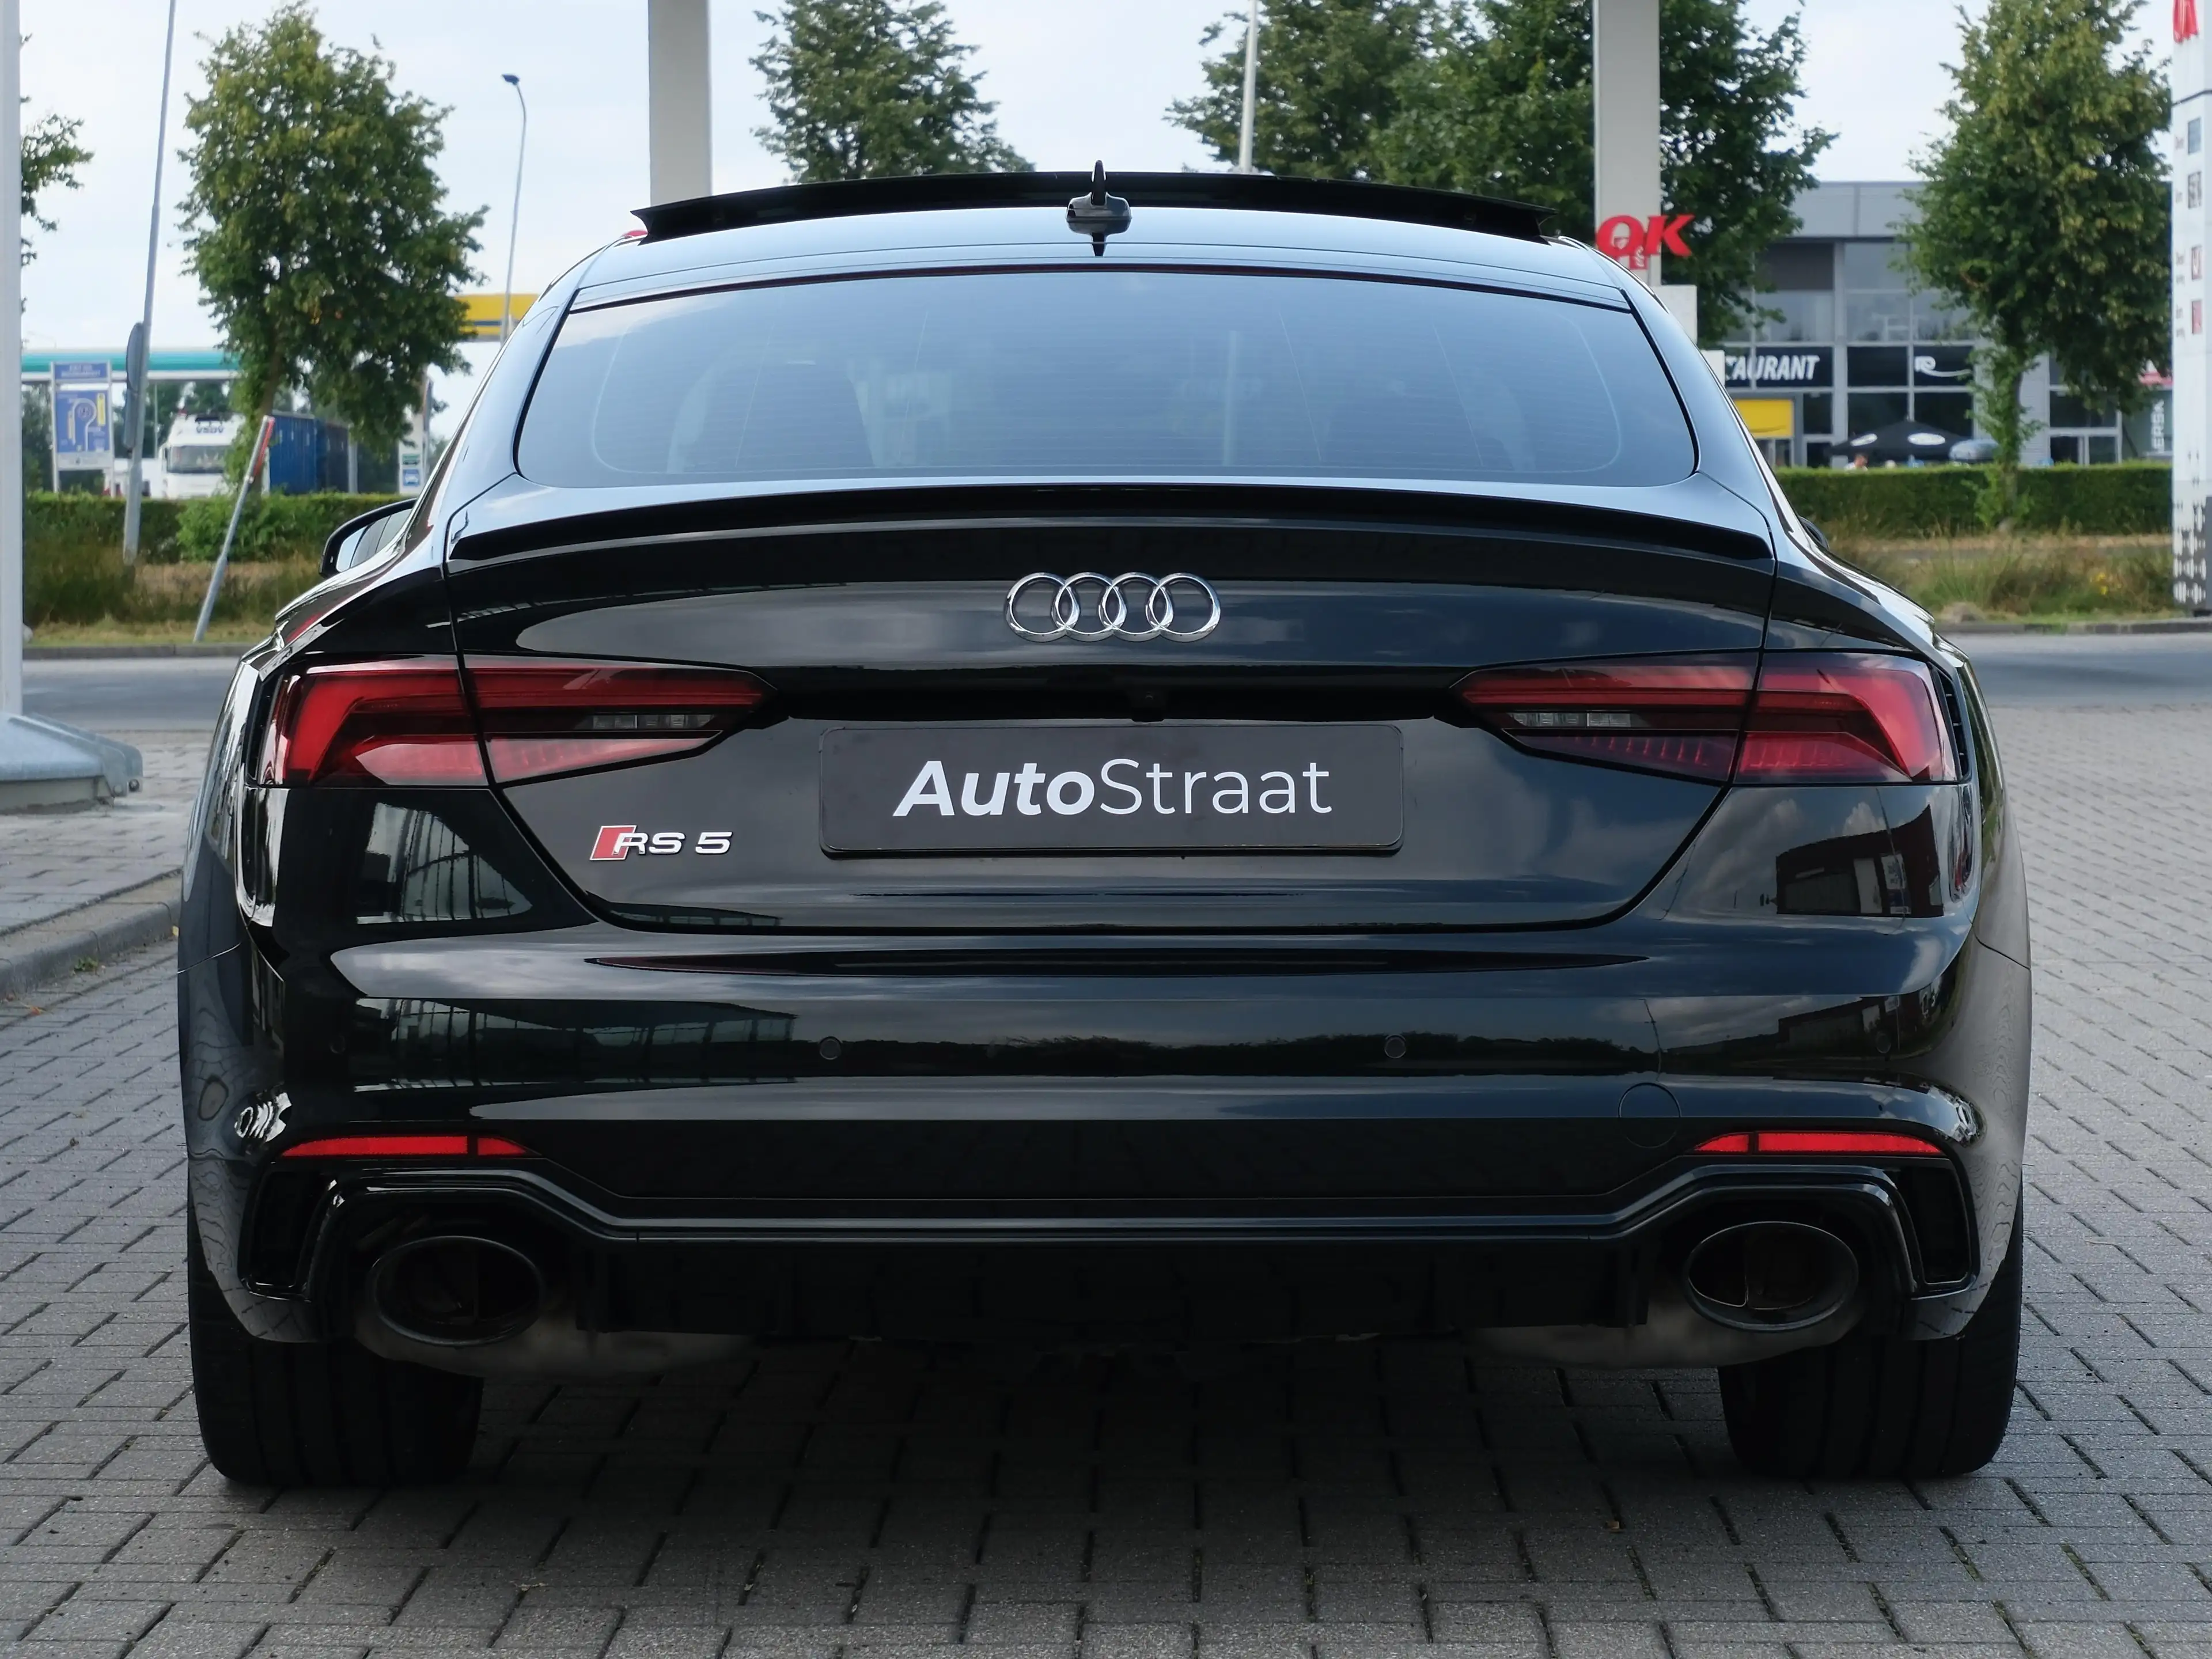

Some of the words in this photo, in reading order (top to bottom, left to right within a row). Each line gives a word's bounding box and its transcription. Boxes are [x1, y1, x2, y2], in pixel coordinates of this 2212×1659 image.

[1596, 215, 1695, 259] OK
[893, 759, 1332, 816] AutoStraat
[605, 830, 685, 855] RS
[695, 832, 733, 854] 5
